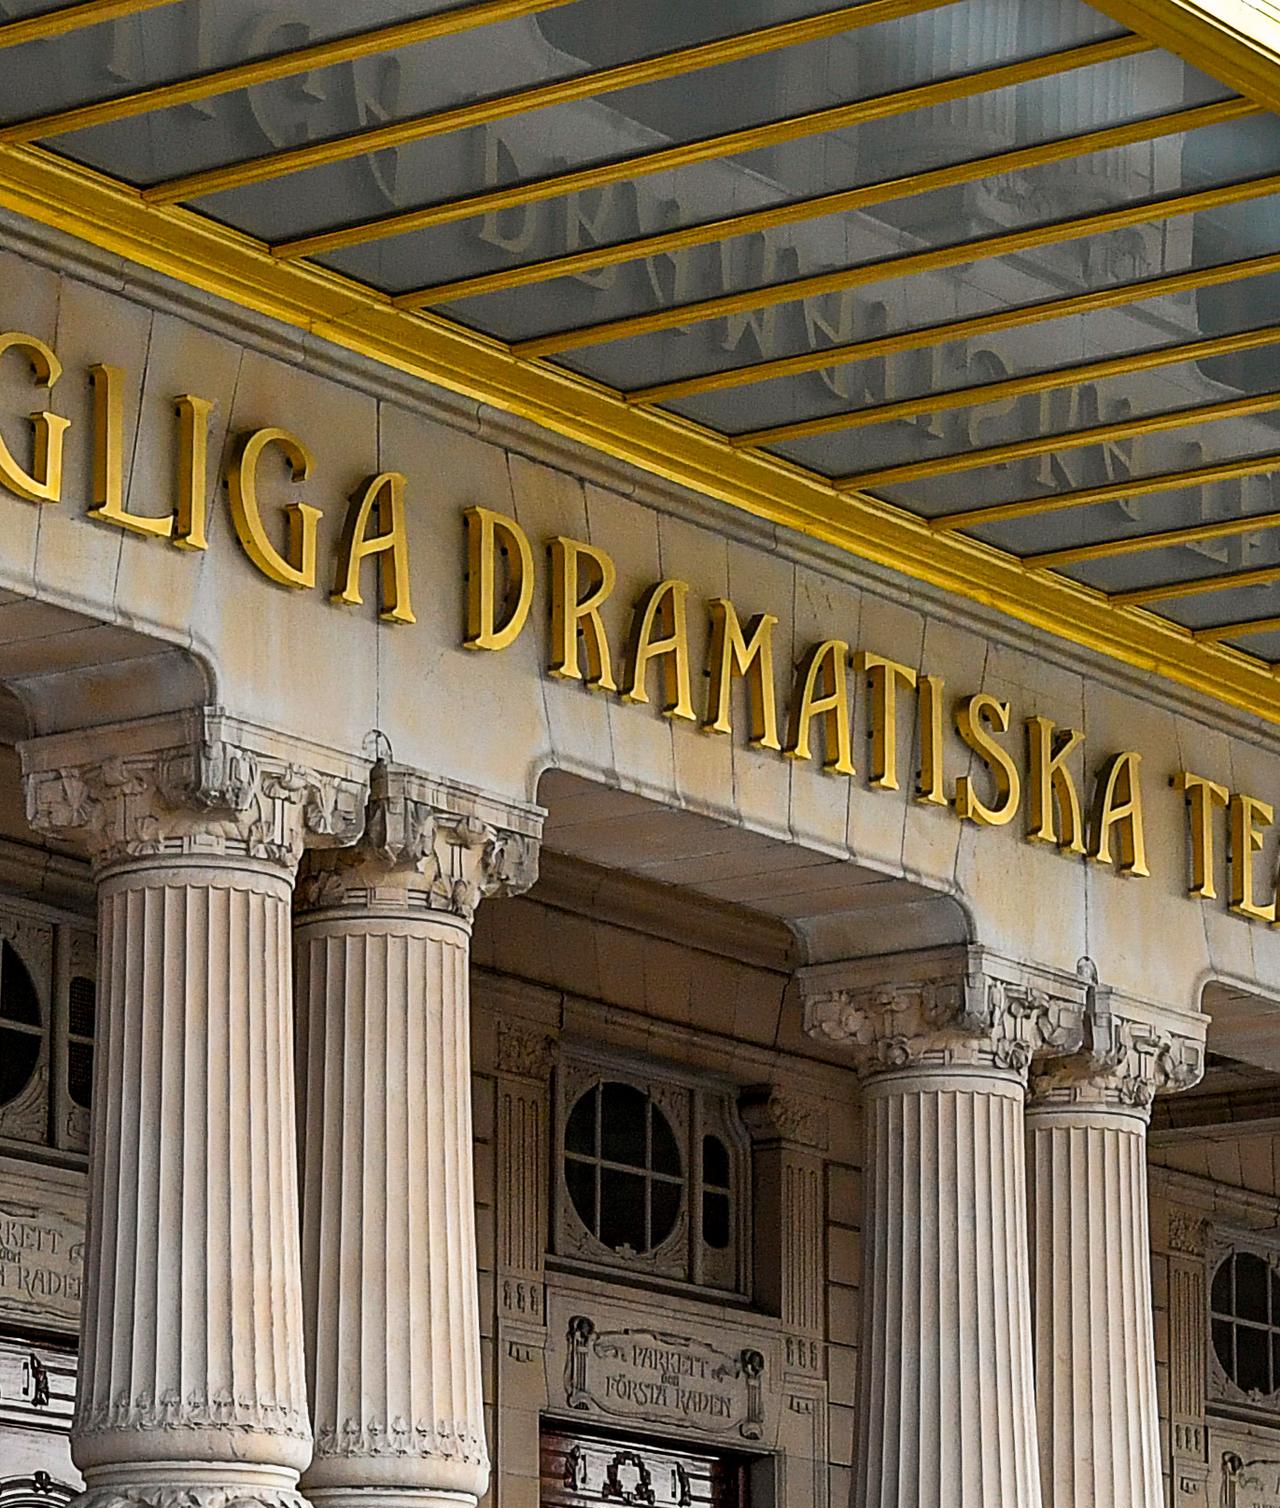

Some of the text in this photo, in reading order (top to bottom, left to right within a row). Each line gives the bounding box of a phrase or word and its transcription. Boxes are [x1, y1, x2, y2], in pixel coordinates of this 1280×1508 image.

[462, 505, 1151, 878] DRAMATISKA
[632, 1344, 709, 1379] PARKETT
[605, 1373, 732, 1419] FÖRSTA RADEN
